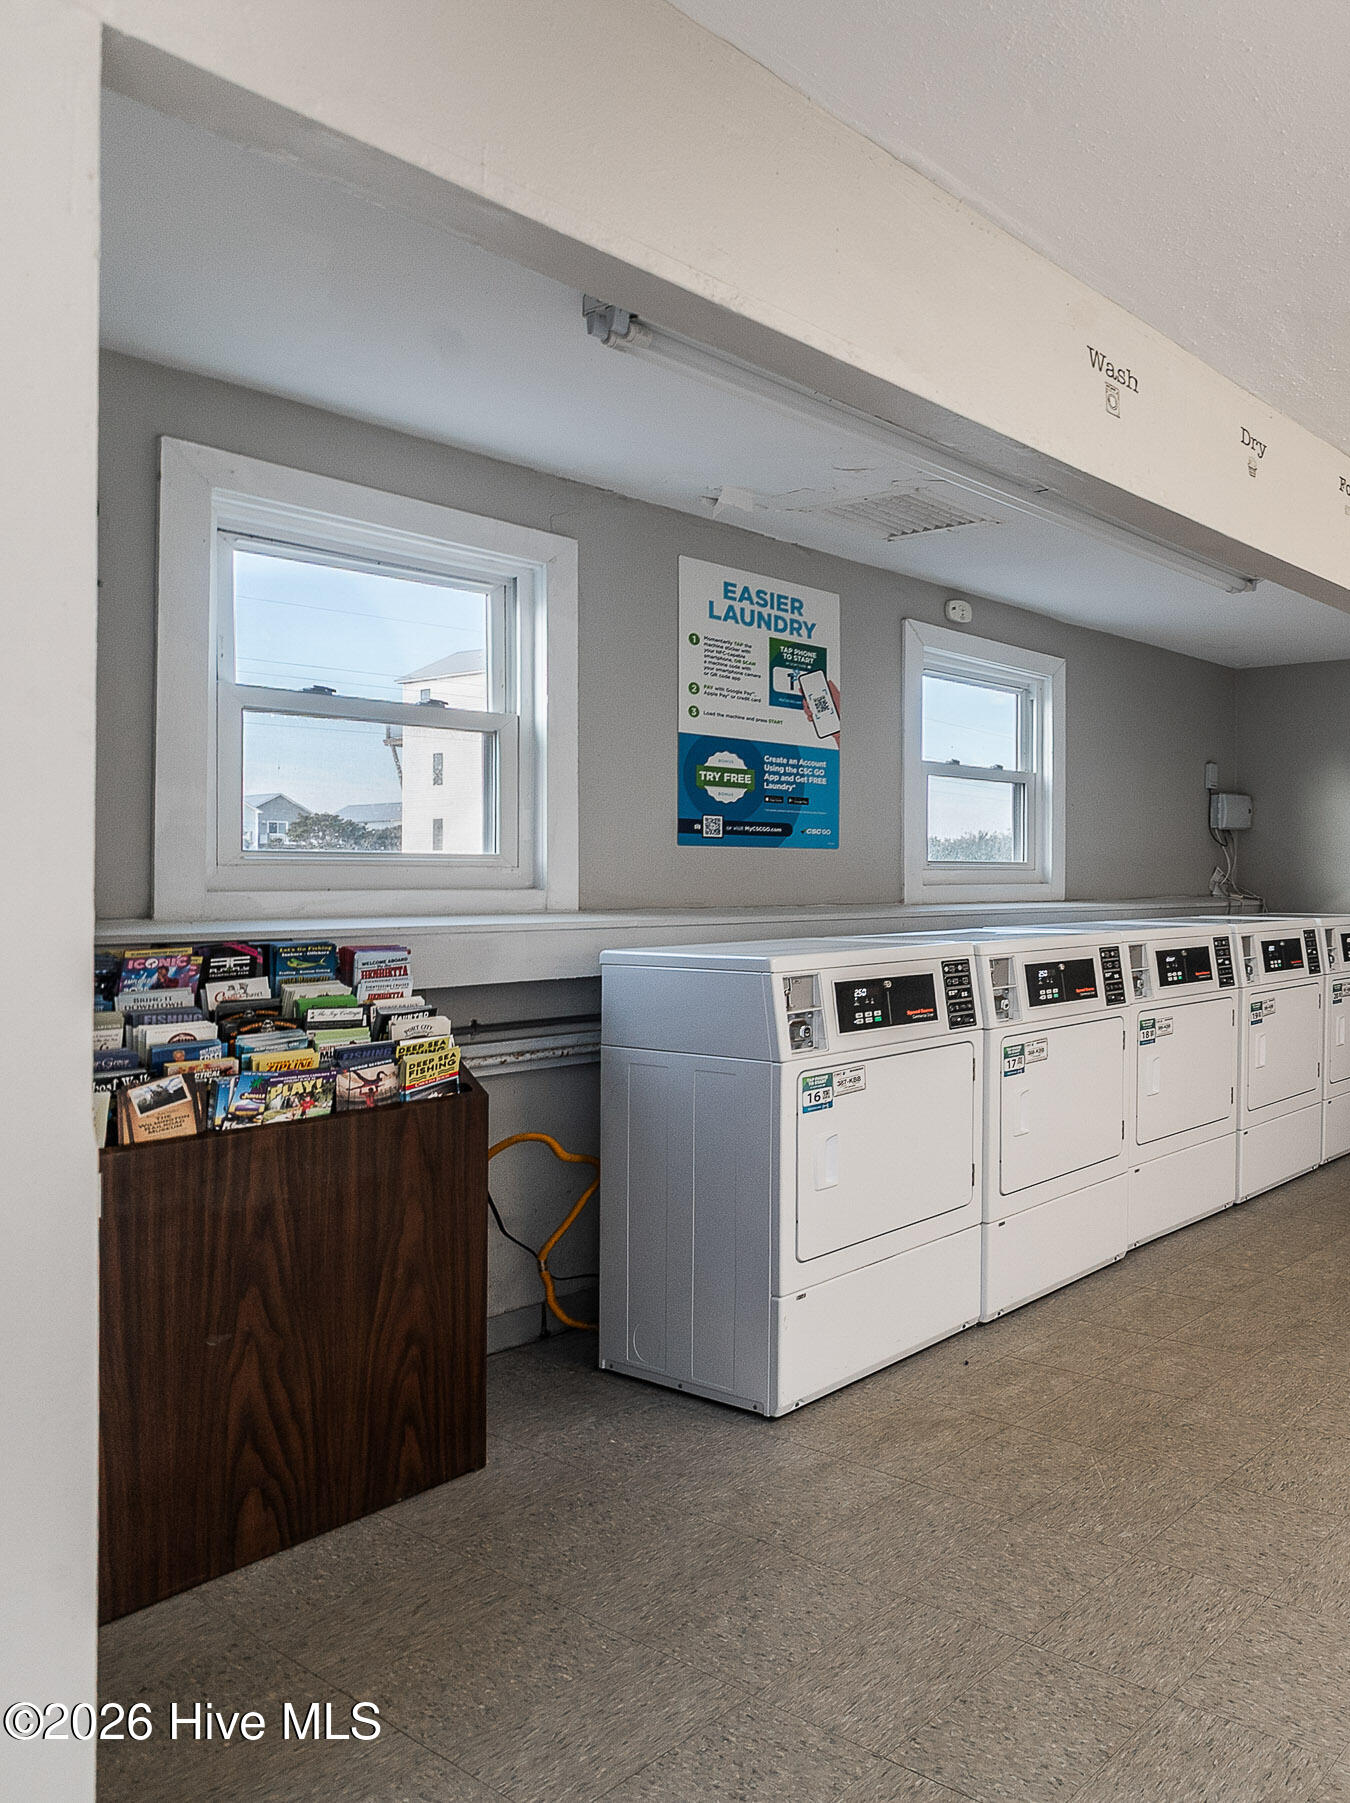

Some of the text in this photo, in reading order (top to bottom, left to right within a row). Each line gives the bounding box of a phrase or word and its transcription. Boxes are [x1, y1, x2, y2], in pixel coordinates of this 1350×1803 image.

[1086, 345, 1139, 394] Wash
[1240, 427, 1267, 458] Dry
[722, 580, 804, 617] EASIER
[707, 600, 817, 640] LAUNDRY
[793, 648, 817, 659] PHONE
[793, 655, 814, 664] START
[691, 684, 697, 692] 2
[691, 708, 697, 716] 3
[764, 755, 787, 764] Create
[799, 759, 827, 768] Account
[764, 764, 785, 774] Using
[798, 767, 813, 775] CSC
[699, 770, 752, 784] TRY FREE
[764, 773, 780, 782] App
[795, 775, 808, 783] Get
[808, 776, 827, 785] FREE
[127, 956, 188, 970] ICONIC
[143, 1013, 203, 1025] FISHING
[1142, 1030, 1150, 1039] 18
[398, 1039, 447, 1054] DEEP SEA
[343, 1047, 393, 1060] FISHING
[266, 1059, 313, 1072] ZIPLINE
[409, 1052, 457, 1070] DEEP SEA
[1007, 1059, 1017, 1069] 17
[409, 1059, 457, 1078] FISHING
[92, 1079, 119, 1093] host
[269, 1078, 323, 1101] PLAY!
[807, 1091, 821, 1104] 16
